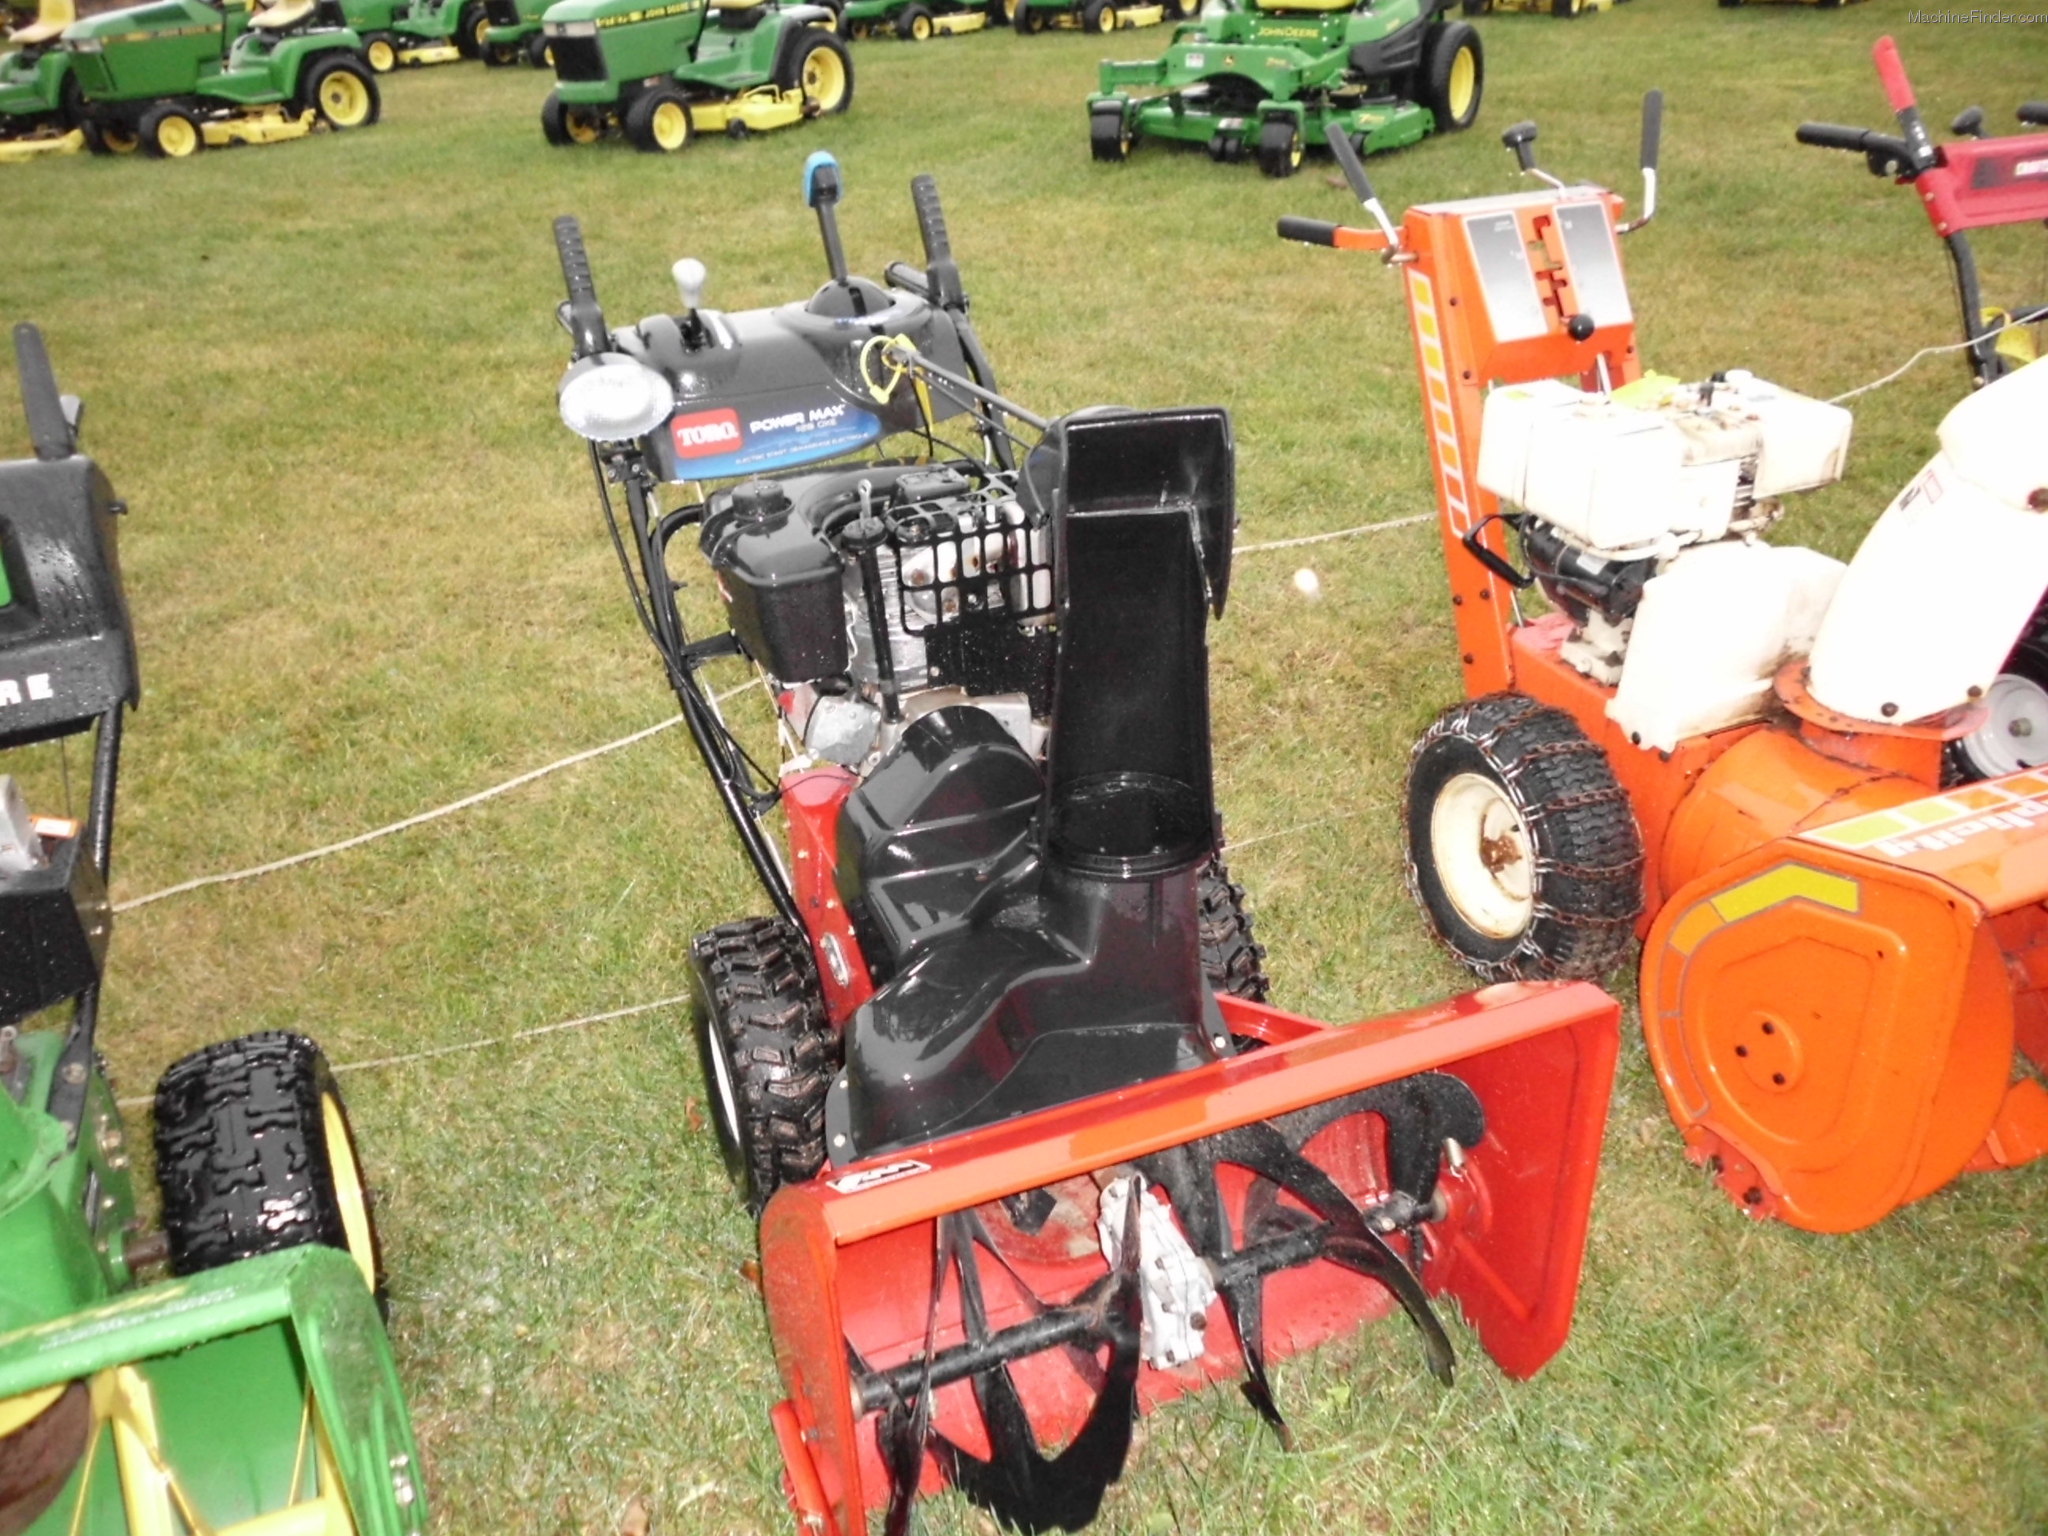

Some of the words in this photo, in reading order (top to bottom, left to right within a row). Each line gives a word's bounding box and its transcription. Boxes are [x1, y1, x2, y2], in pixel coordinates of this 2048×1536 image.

[750, 412, 805, 434] POWER
[810, 404, 843, 421] MAX
[677, 421, 739, 447] TORO
